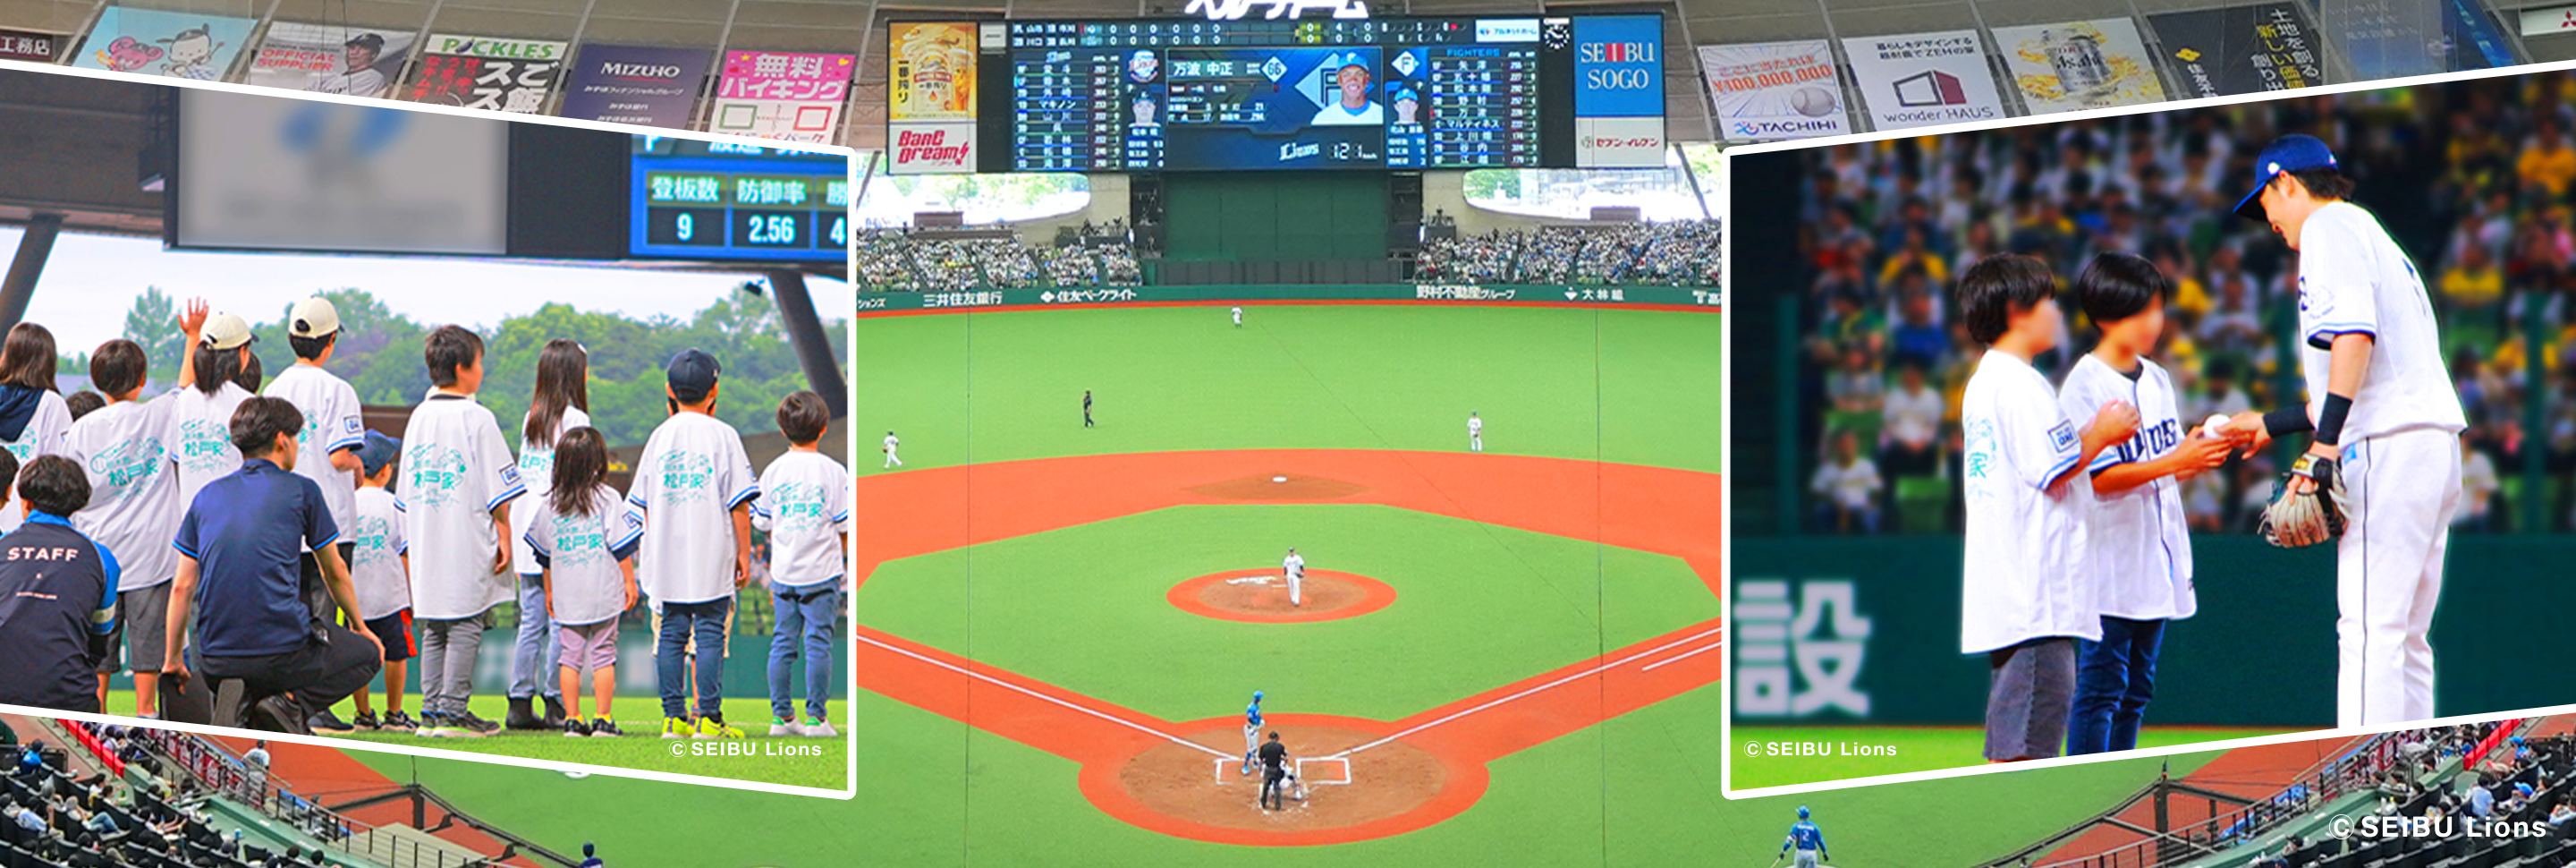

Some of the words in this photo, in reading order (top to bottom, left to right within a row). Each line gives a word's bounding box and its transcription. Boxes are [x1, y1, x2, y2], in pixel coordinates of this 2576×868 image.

[261, 48, 336, 63] OFFICIAL
[1580, 43, 1656, 64] SEIBU
[257, 57, 334, 72] SUPPLIER
[600, 62, 681, 78] MIZUHO
[753, 54, 825, 79] 無料
[1207, 62, 1233, 76] 中正
[1267, 63, 1282, 76] 66
[1588, 69, 1649, 89] SOGO
[721, 77, 846, 99] バイキング
[1884, 111, 1941, 123] wonder
[1945, 106, 1995, 120] HAUS
[1758, 120, 1838, 133] TACHIHI
[651, 175, 719, 202] 登板数
[736, 178, 807, 205] 防御率
[676, 212, 693, 241] 9
[748, 215, 795, 243] 2.56
[923, 291, 1003, 307] 三井住友銀行
[1582, 288, 1624, 301] 大林組
[7, 547, 79, 562] STAFF
[1733, 580, 1875, 716] 設
